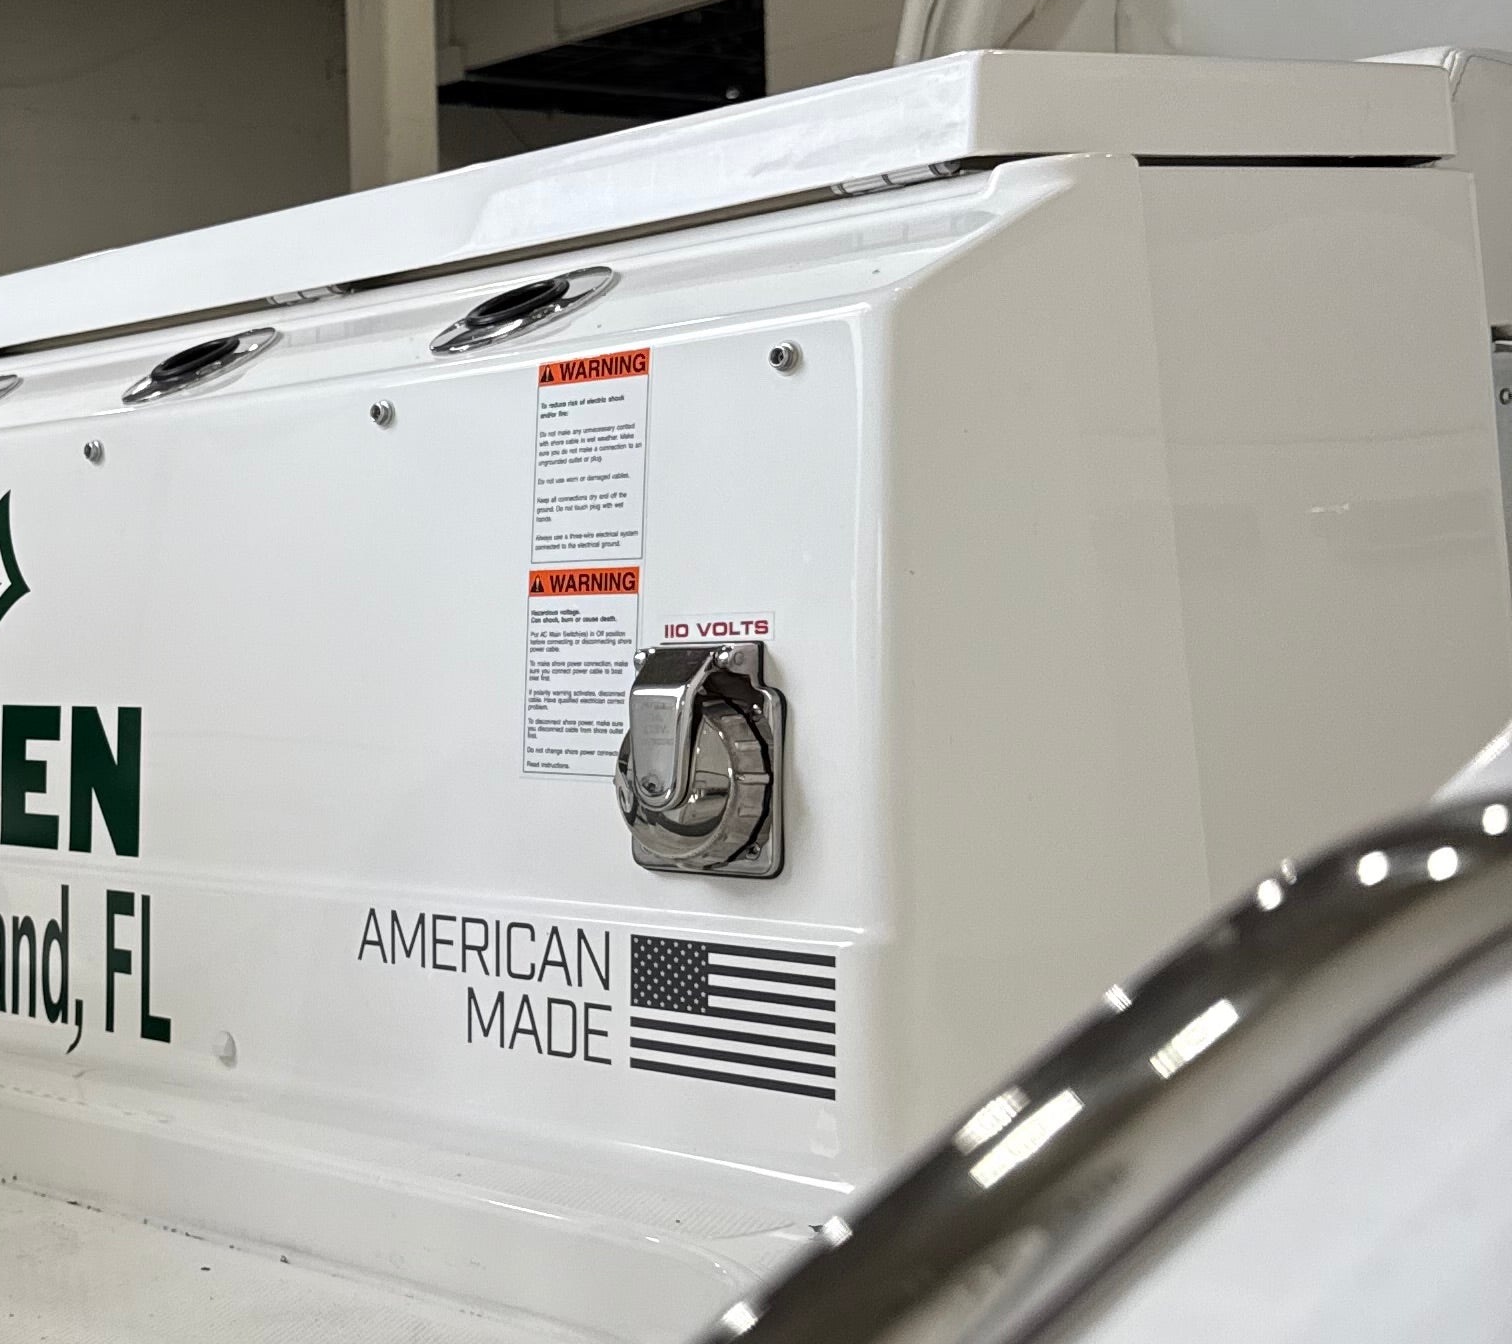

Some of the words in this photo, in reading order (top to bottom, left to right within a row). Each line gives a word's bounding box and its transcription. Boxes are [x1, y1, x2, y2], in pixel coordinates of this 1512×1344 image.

[559, 354, 646, 382] WARNING
[550, 572, 636, 594] WARNING
[697, 620, 768, 636] VOLTS
[106, 888, 172, 1044] FL
[358, 908, 610, 991] AMERICAN
[467, 986, 612, 1065] MADE
